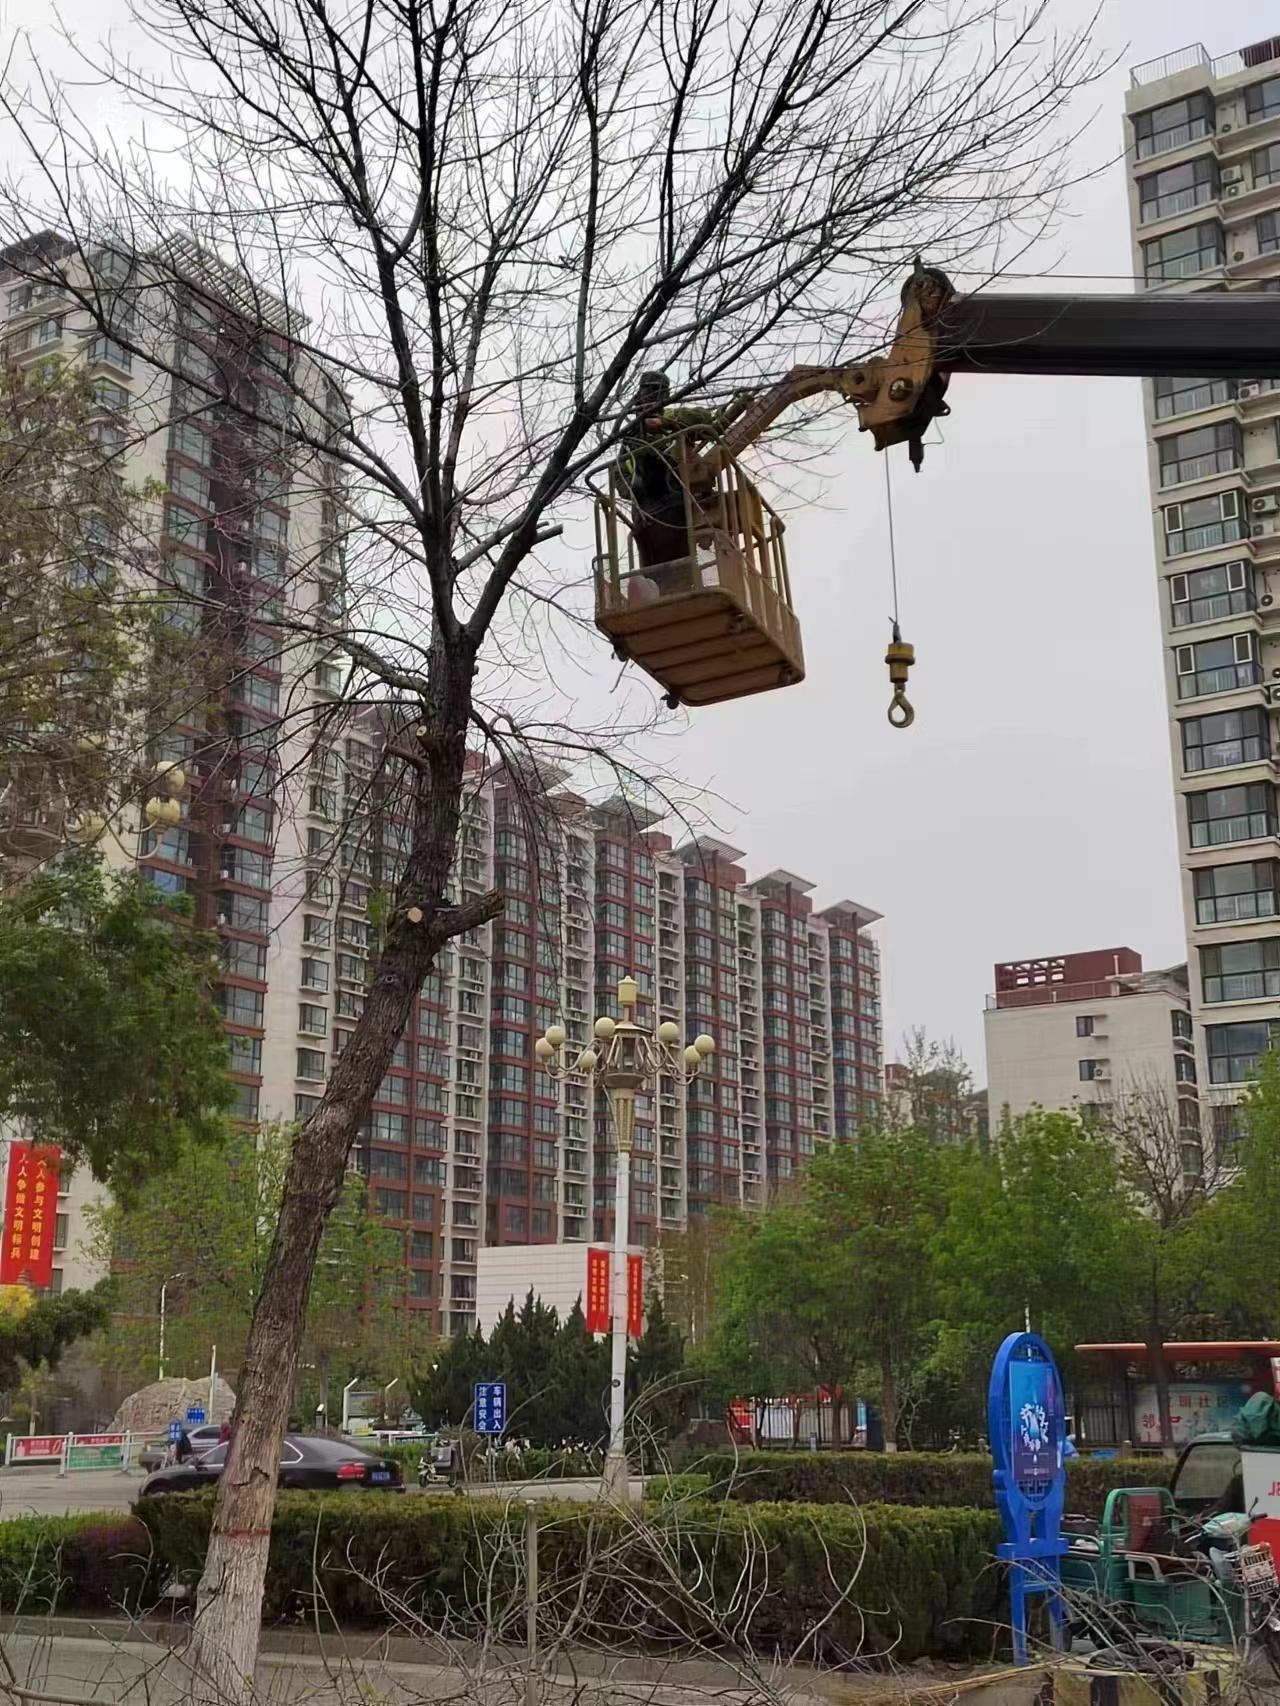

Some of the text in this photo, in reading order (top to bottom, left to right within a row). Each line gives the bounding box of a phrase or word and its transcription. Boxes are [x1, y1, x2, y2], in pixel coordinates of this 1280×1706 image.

[479, 1386, 487, 1430] 注意安全
[493, 1386, 502, 1430] 车辆出入
